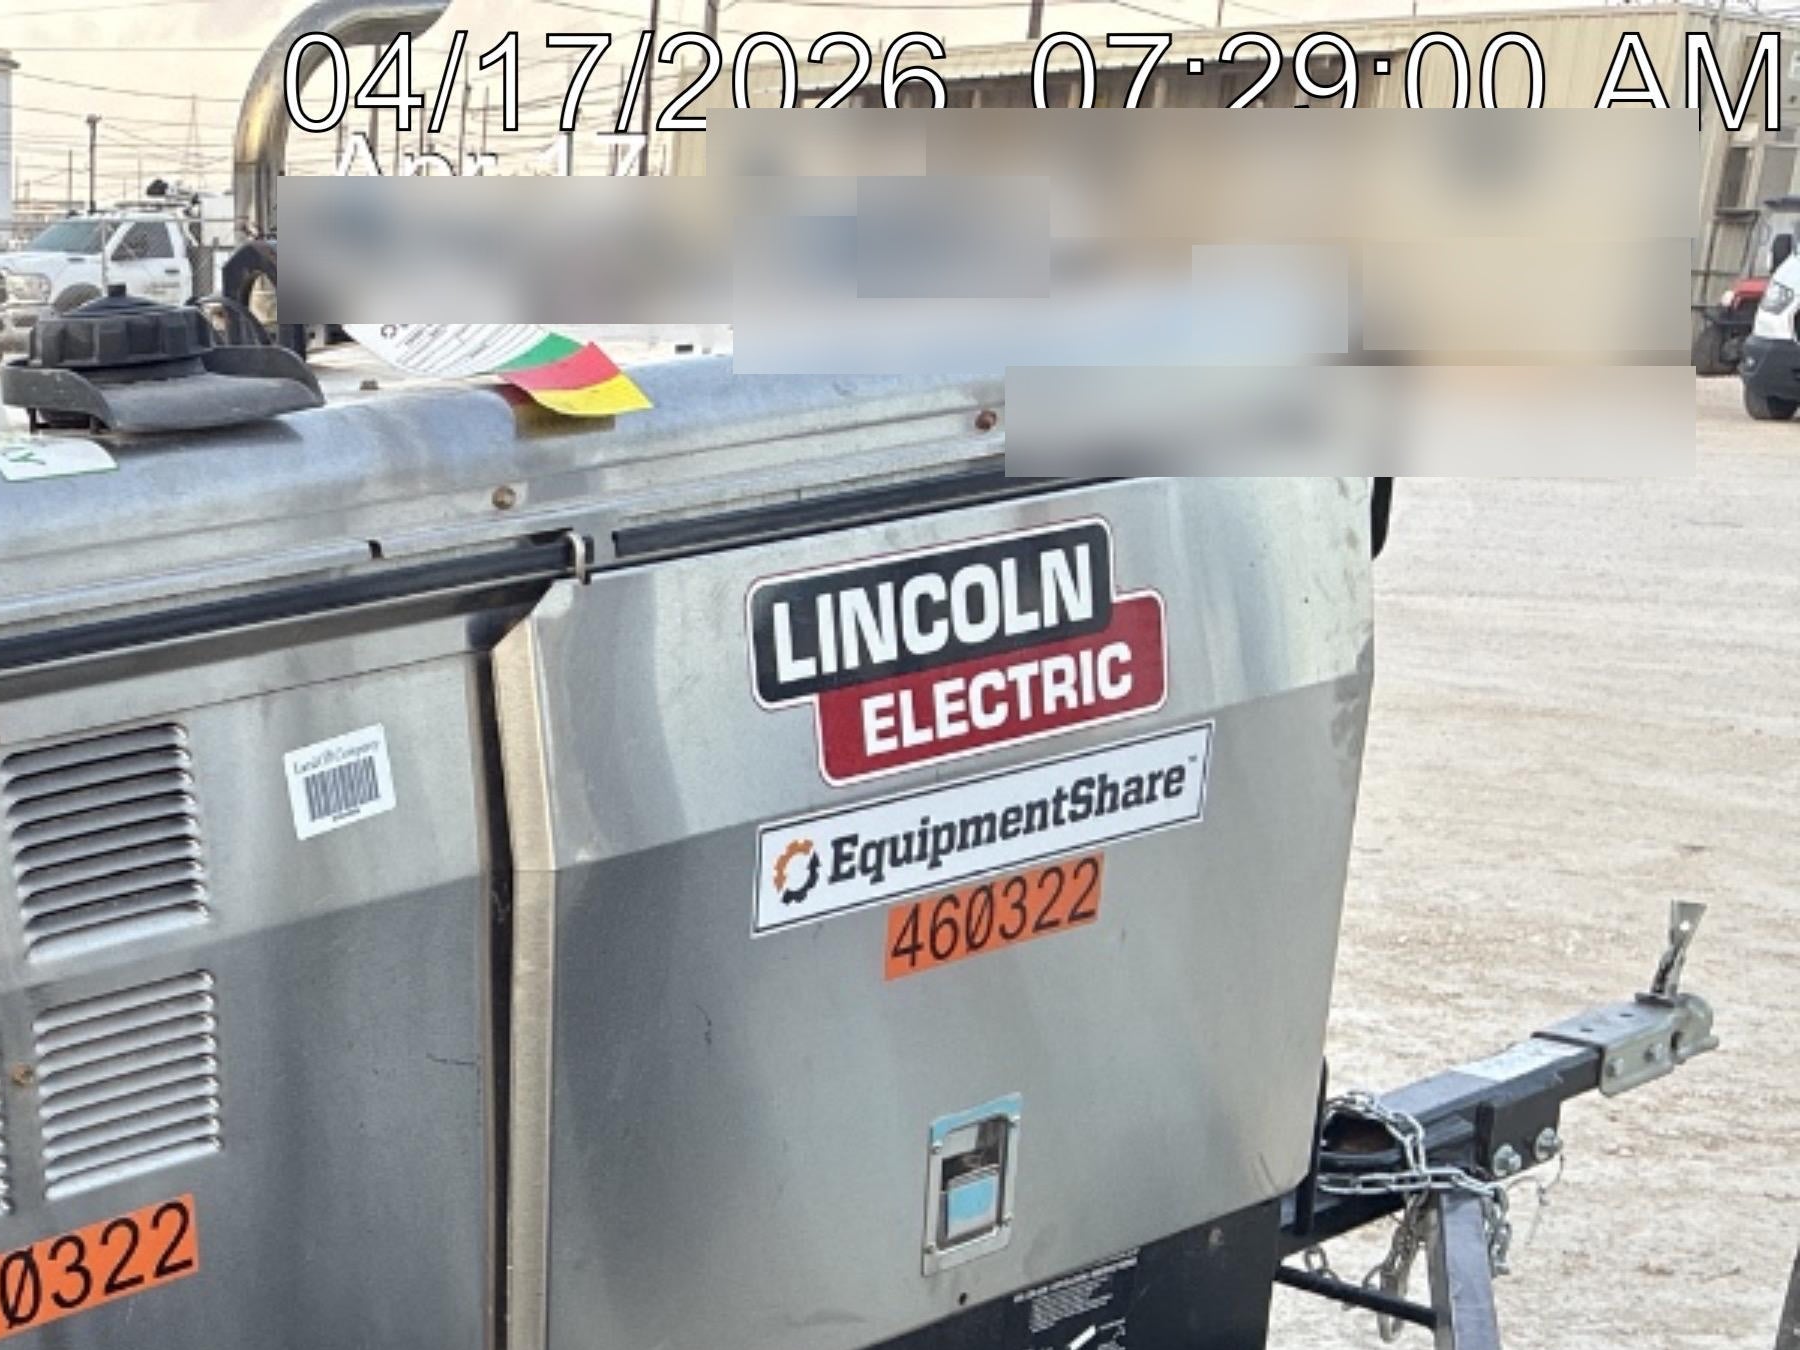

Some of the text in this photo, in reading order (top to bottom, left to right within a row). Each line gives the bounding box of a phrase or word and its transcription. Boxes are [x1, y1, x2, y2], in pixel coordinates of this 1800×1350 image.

[772, 542, 1094, 685] LINCOLN
[861, 641, 1133, 758] ELECTRIC
[826, 763, 1187, 886] EquipmentShare
[890, 856, 1101, 969] 460322
